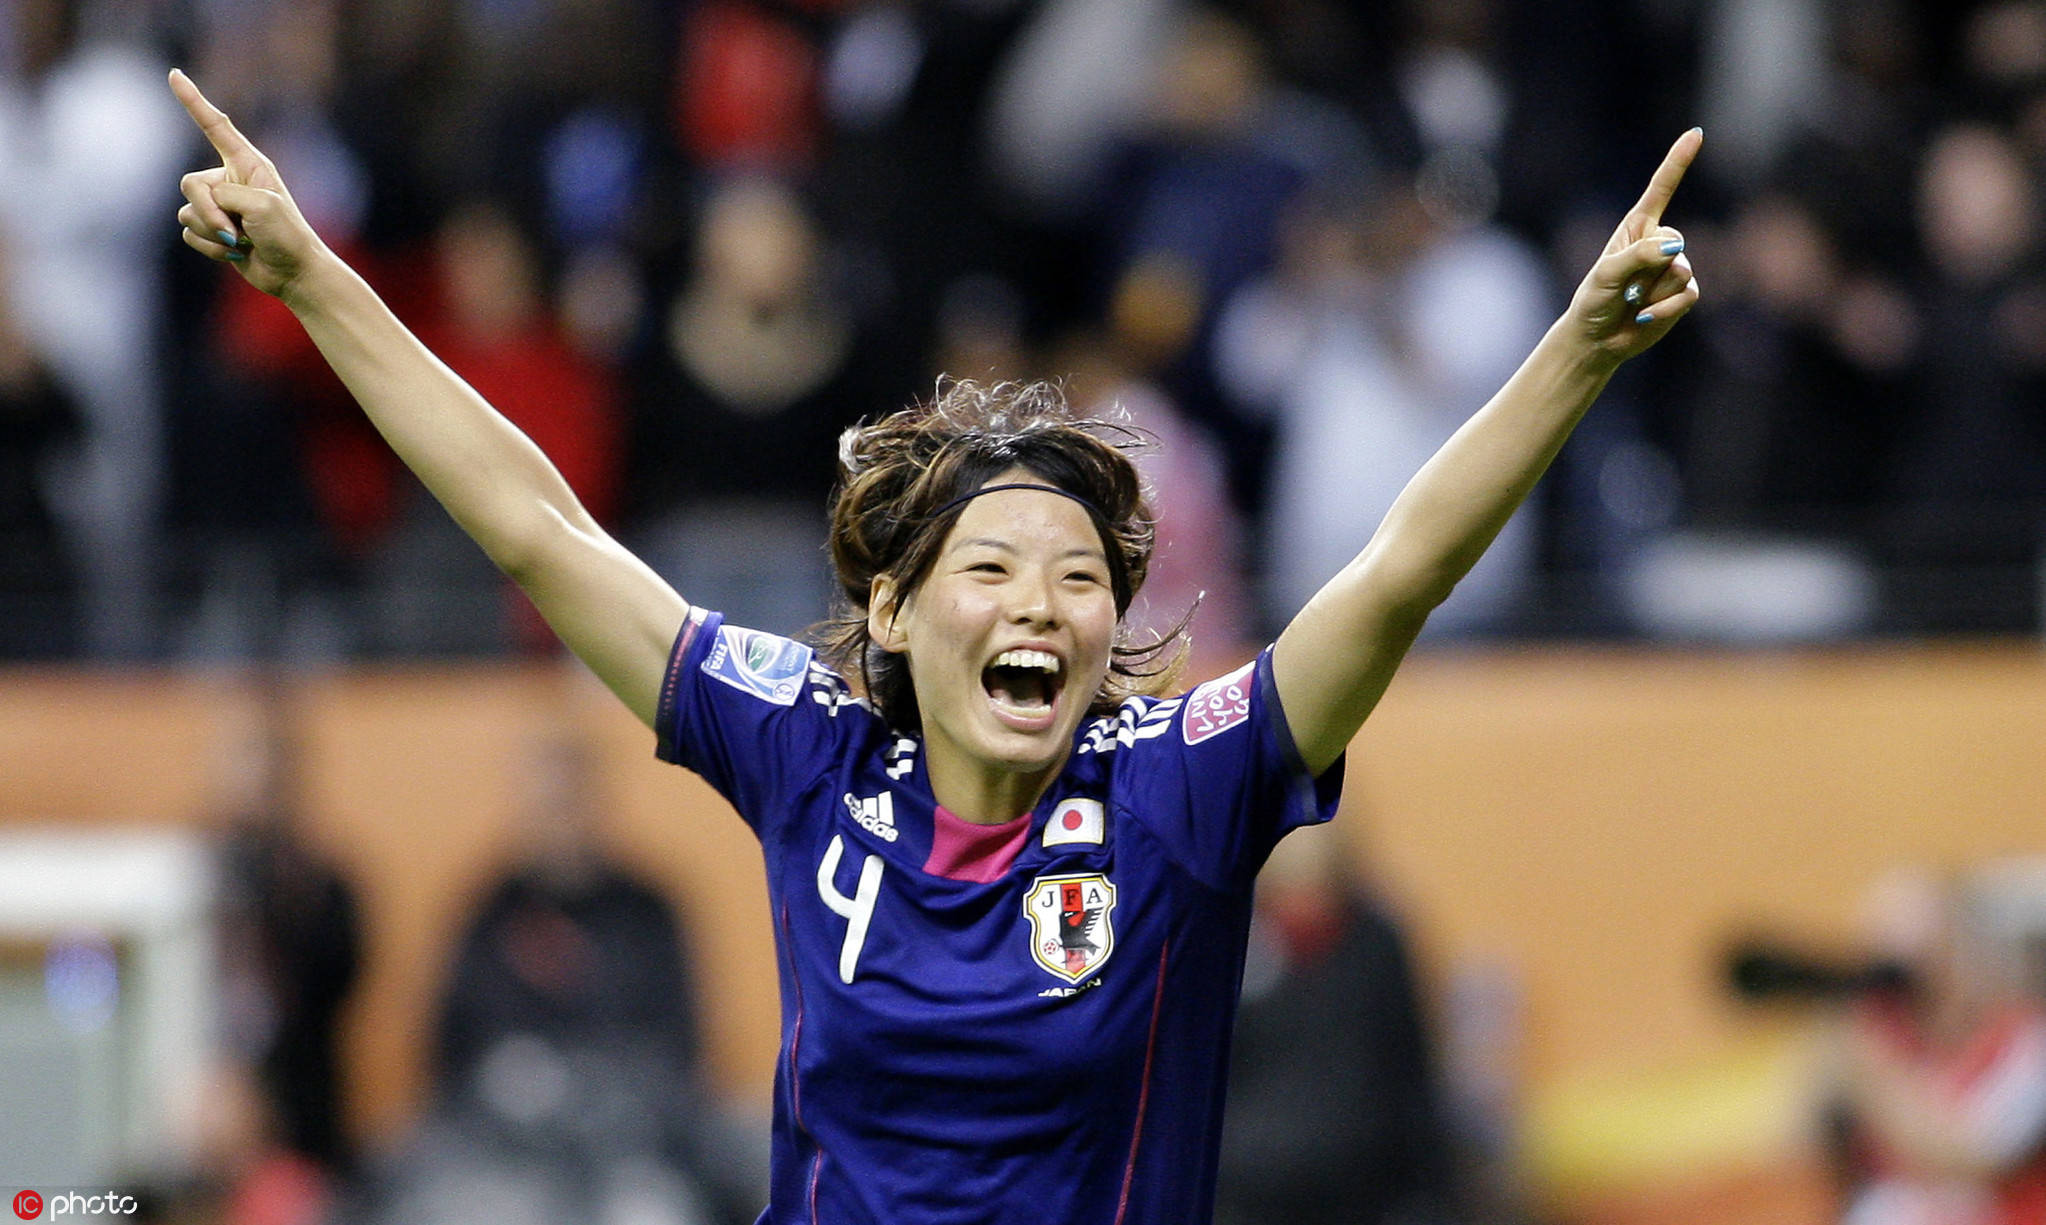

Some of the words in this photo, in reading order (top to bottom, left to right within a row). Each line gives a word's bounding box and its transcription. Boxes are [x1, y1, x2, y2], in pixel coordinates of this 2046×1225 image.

[709, 642, 729, 670] FIFA
[843, 792, 899, 842] adidas
[816, 833, 885, 985] 4
